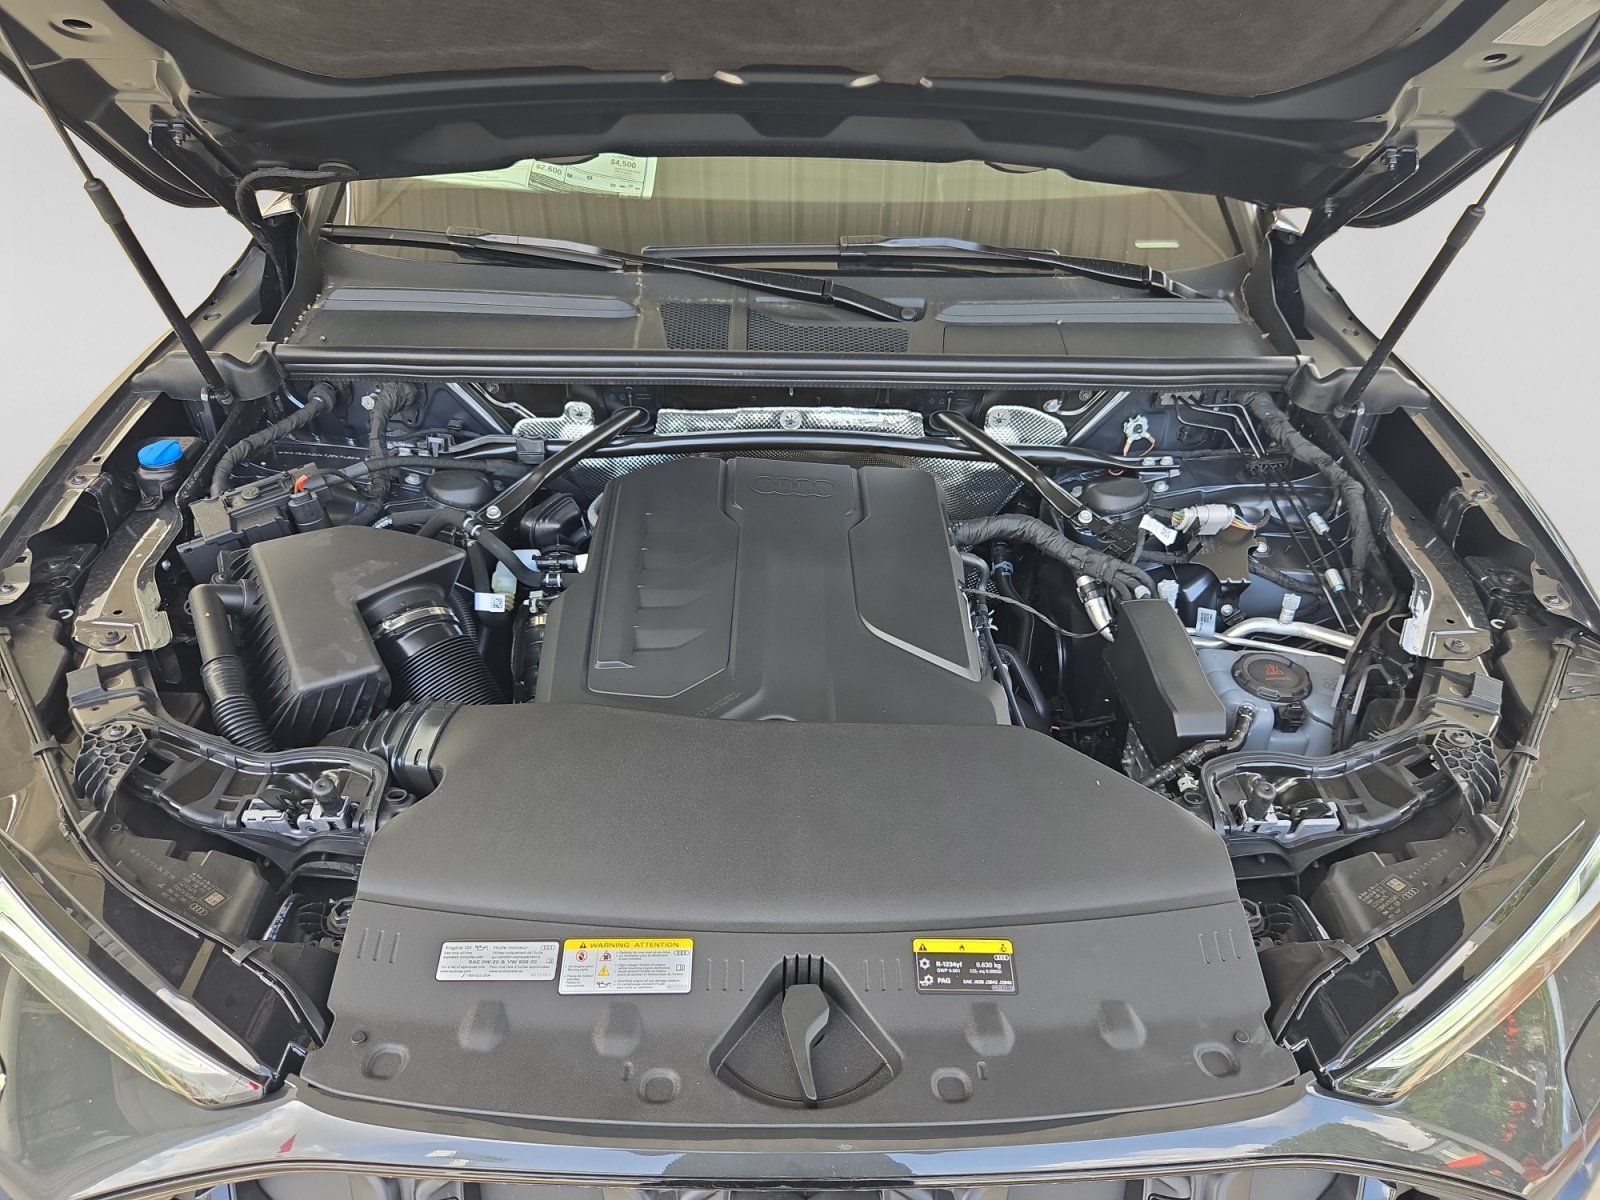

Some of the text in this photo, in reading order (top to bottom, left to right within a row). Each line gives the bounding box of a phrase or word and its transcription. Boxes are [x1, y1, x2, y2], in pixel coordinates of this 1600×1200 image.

[610, 159, 637, 169] $4,500
[535, 163, 563, 176] $2,600
[936, 960, 962, 969] R-1234yf
[993, 962, 1002, 970] kg
